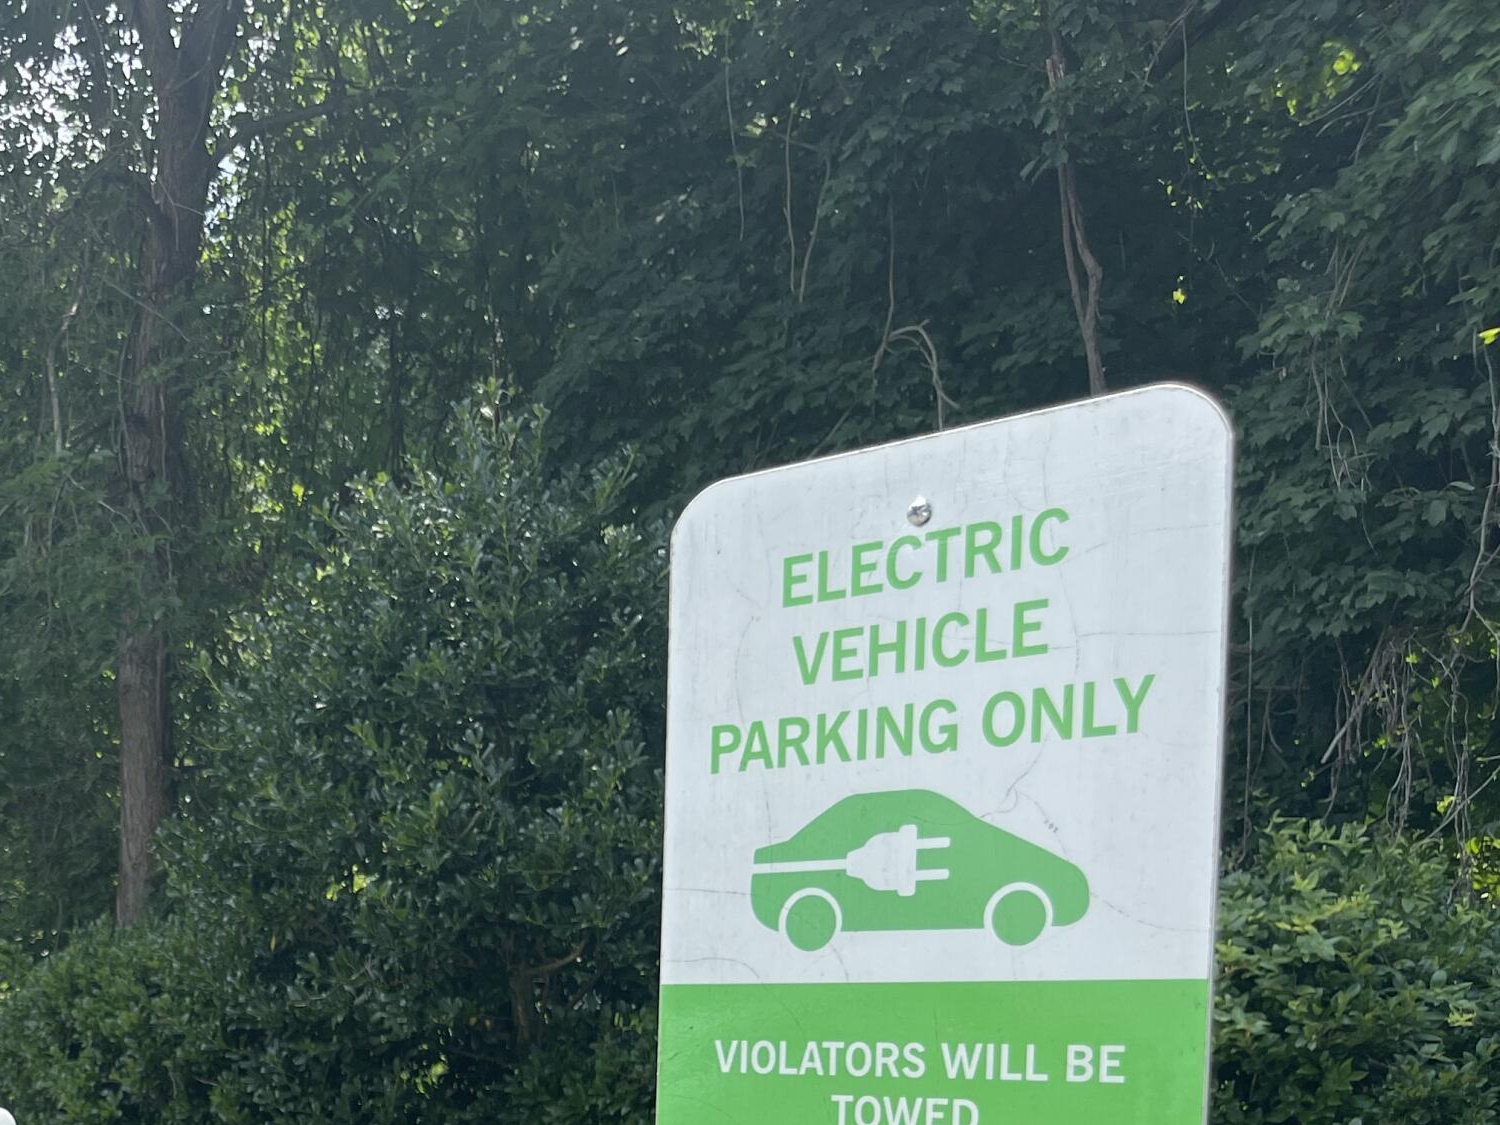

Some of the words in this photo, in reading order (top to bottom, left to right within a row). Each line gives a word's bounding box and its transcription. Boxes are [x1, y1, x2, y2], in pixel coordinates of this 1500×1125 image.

[781, 506, 1070, 609] ELECTRIC
[793, 597, 1050, 686] VEHICLE
[709, 698, 959, 775] PARKING
[980, 673, 1156, 748] ONLY
[714, 1039, 926, 1080] VIOLATORS
[941, 1042, 1049, 1082] WILL
[1065, 1044, 1126, 1084] BE
